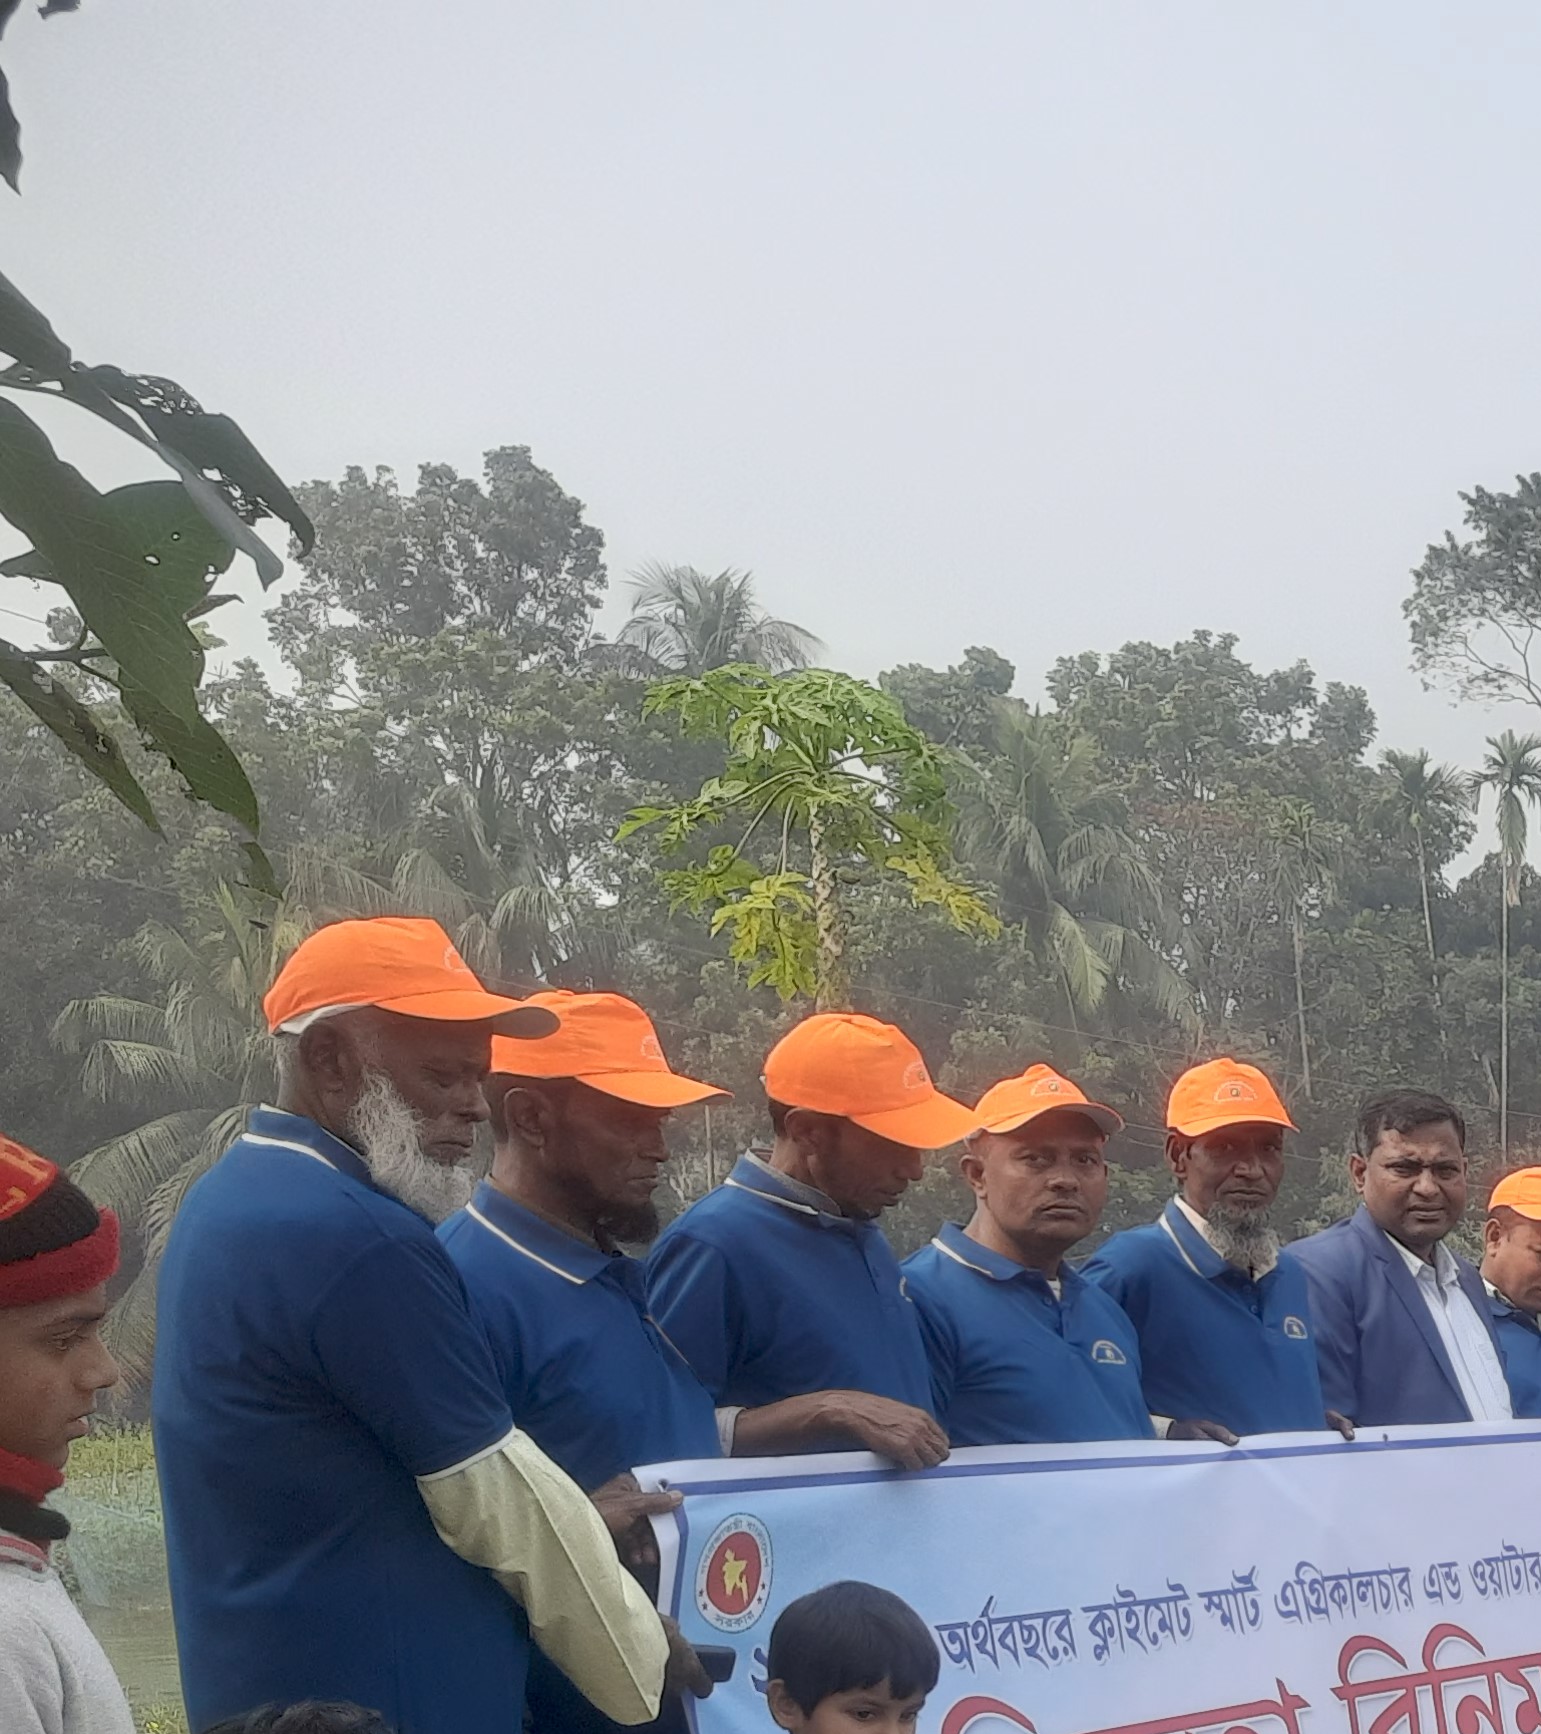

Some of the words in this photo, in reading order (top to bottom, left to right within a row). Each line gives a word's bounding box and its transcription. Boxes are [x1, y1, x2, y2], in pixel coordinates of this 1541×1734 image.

[934, 1595, 1077, 1675] অর্থবছরে
[1080, 1583, 1191, 1662] ক্লাইমেট
[1196, 1564, 1260, 1636] স্মার্ট
[1274, 1560, 1415, 1625] এগ্রিকালচার
[1423, 1560, 1462, 1606] এন্ড
